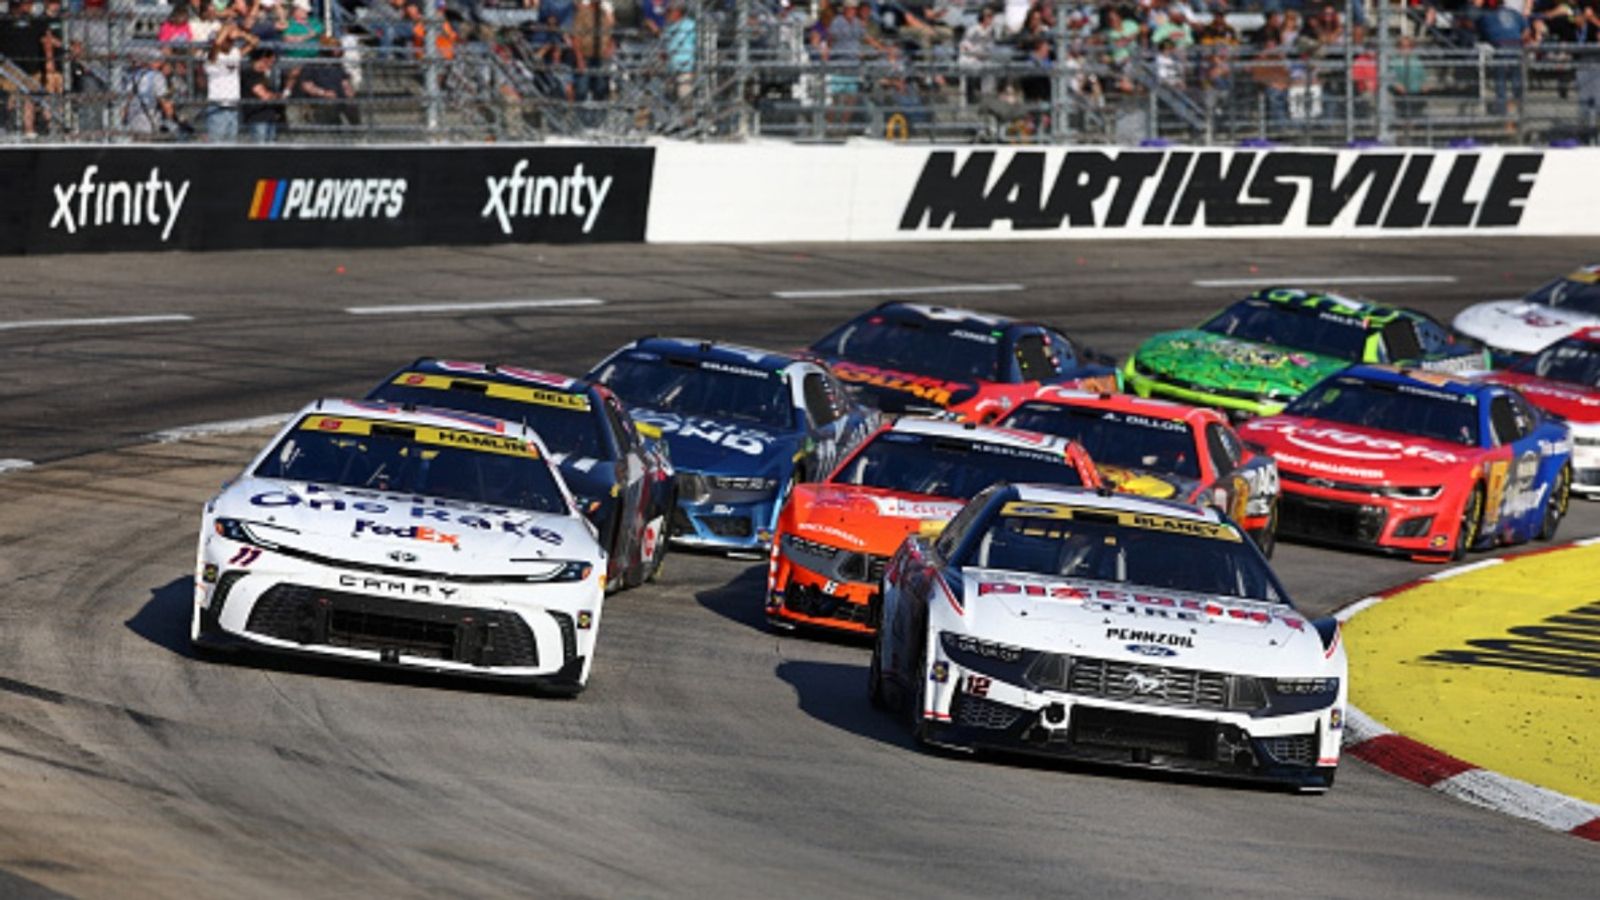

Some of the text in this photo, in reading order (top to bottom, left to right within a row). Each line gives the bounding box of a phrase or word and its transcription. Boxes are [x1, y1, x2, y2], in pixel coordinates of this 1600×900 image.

[282, 177, 408, 220] PLAYOFFS
[482, 160, 613, 235] xfinity
[899, 149, 1545, 230] MARTINSVILLE
[50, 165, 190, 240] xfinity
[950, 328, 998, 345] JONES
[532, 389, 580, 407] BELL
[1101, 412, 1189, 434] A. DILLON
[438, 431, 531, 453] HAMLIN
[353, 517, 461, 546] FedEx
[1133, 514, 1220, 538] BLANEY
[226, 546, 264, 567] 11
[338, 573, 459, 600] CAMRY
[1106, 627, 1196, 650] PENNZOIL
[965, 675, 992, 699] 12
